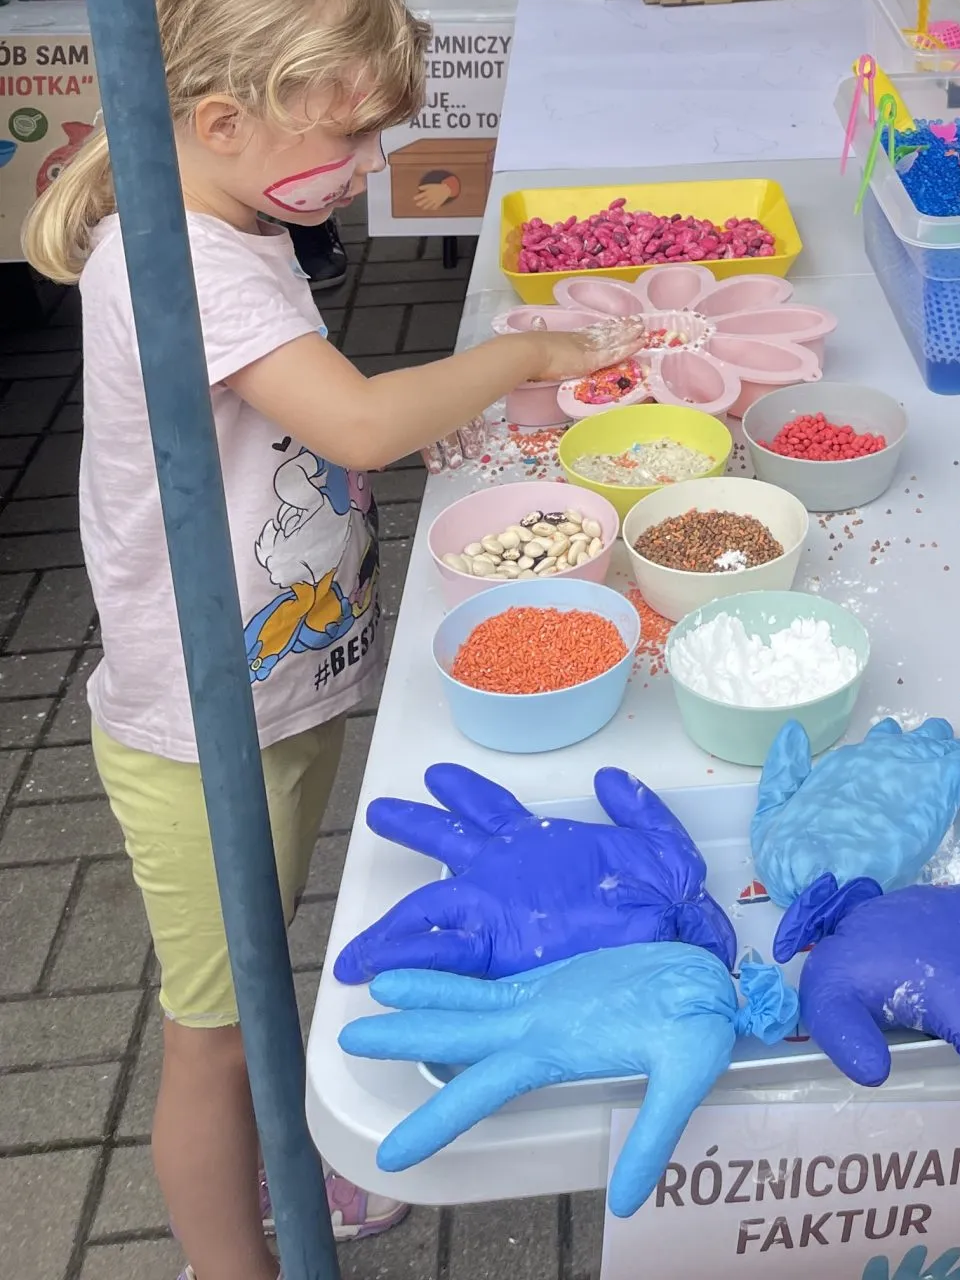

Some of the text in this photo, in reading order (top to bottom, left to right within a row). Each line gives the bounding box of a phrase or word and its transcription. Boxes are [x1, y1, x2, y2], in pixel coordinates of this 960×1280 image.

[36, 45, 88, 65] SAM
[409, 113, 501, 128] ALE CO TO
[736, 1203, 932, 1254] FAKTUR
